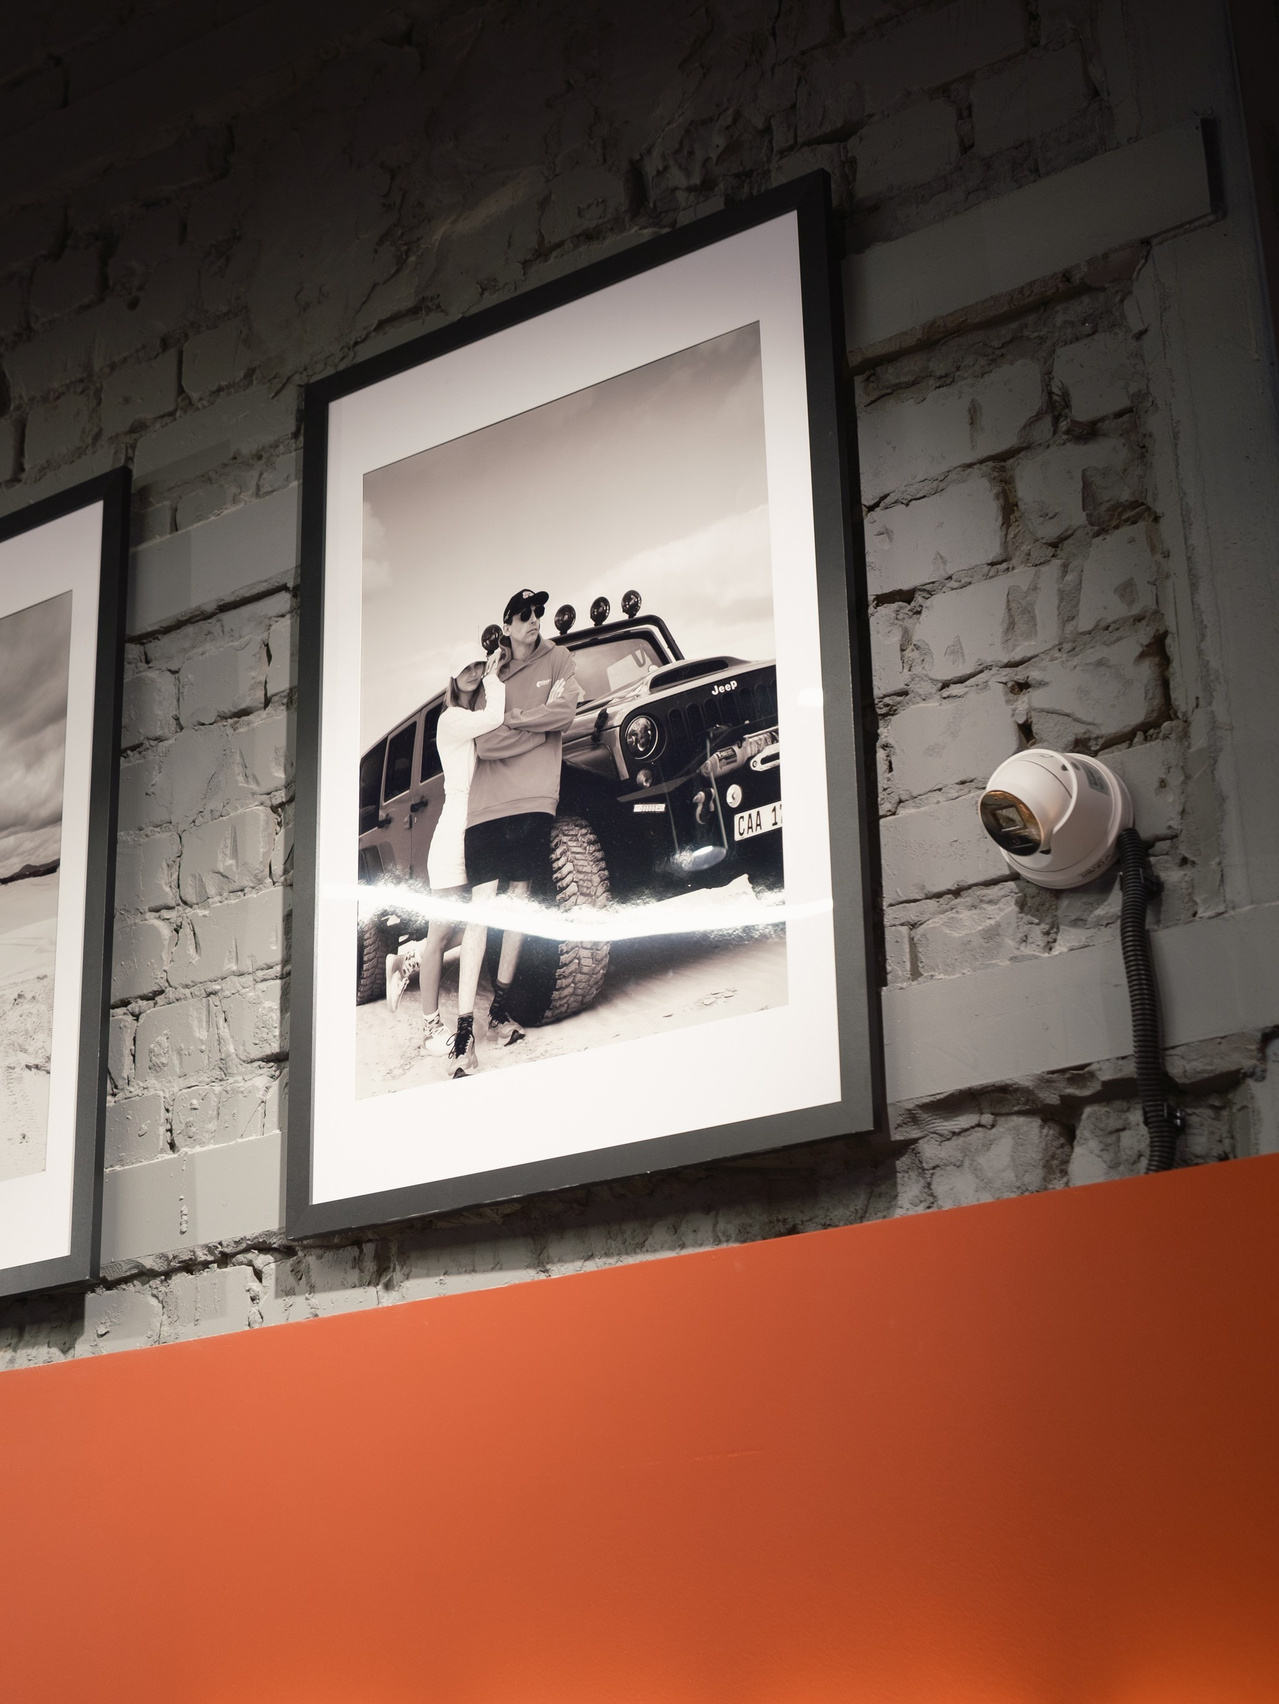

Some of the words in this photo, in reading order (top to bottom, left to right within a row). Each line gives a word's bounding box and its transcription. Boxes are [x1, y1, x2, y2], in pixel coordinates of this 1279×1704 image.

[711, 680, 738, 696] Jeep
[738, 810, 762, 836] CAA
[771, 804, 783, 827] 1
